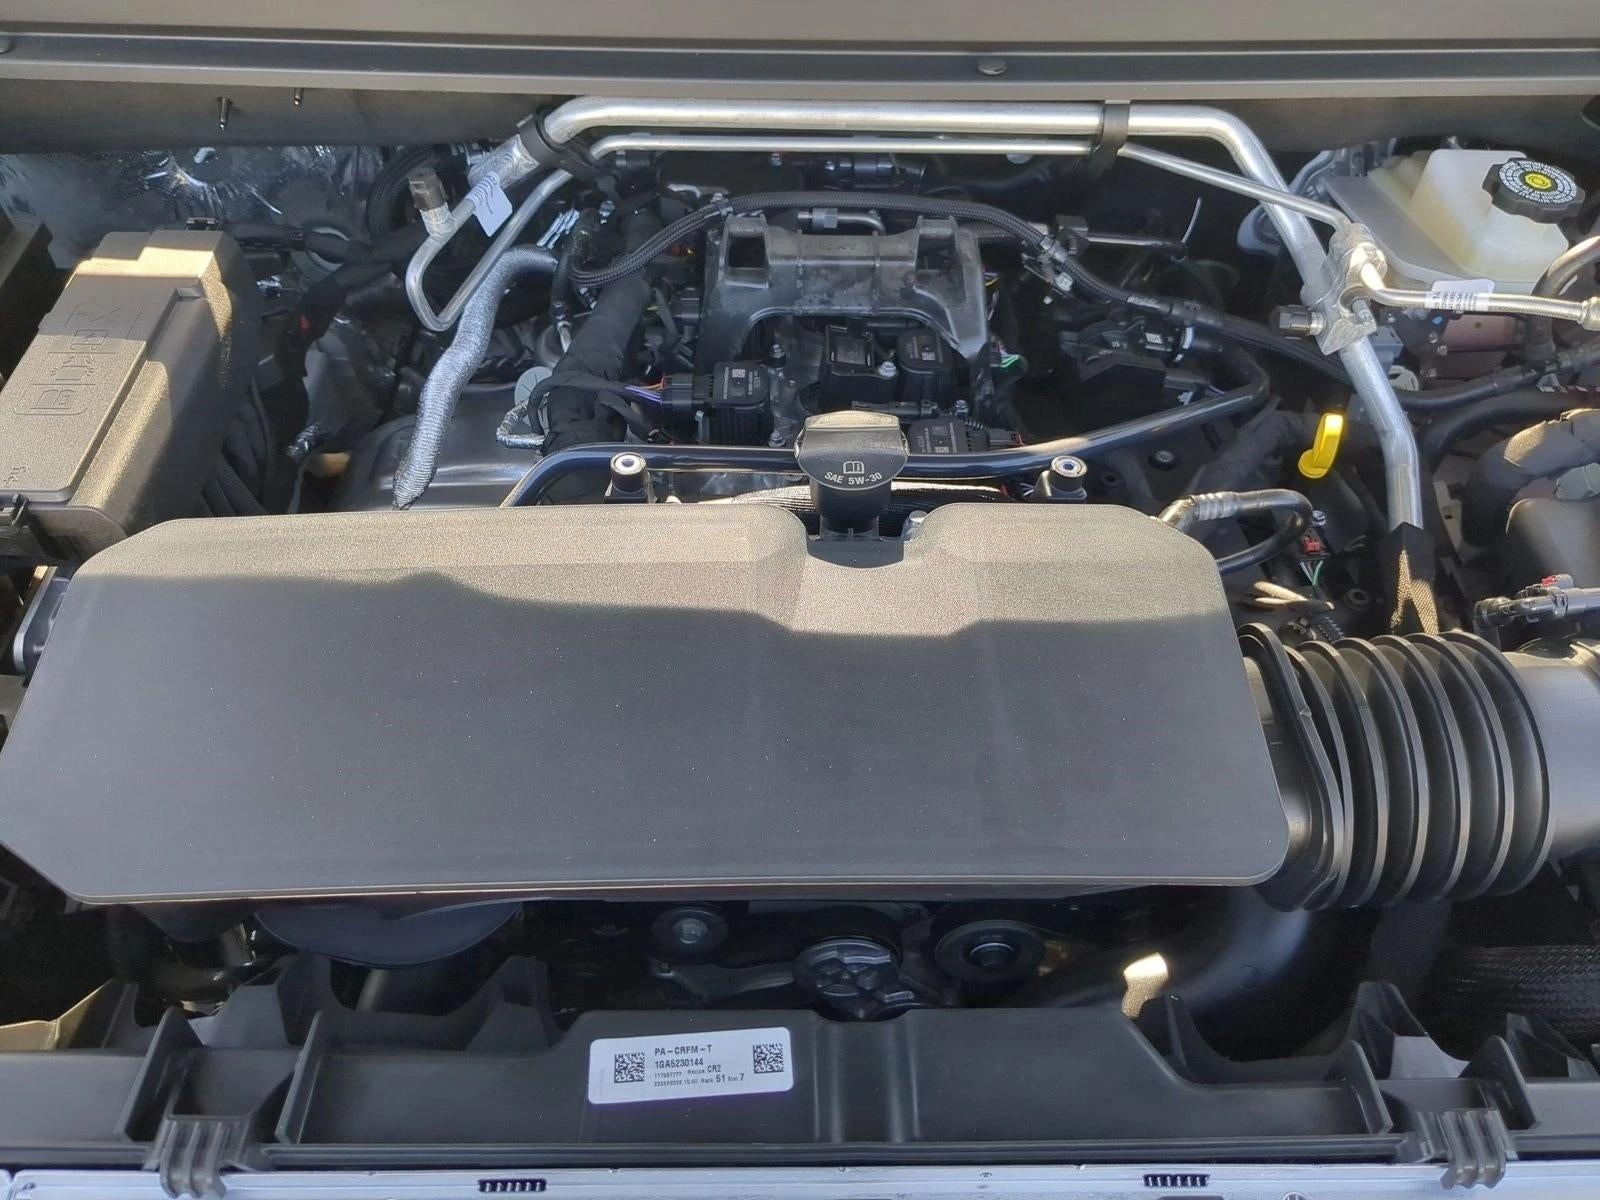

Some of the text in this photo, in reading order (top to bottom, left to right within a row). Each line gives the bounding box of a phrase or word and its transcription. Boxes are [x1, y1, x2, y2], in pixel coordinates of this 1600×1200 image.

[824, 472, 882, 485] SAE 5W-30
[655, 1058, 703, 1068] 1GA5230144
[707, 1064, 721, 1073] CR2
[716, 1075, 725, 1083] 51
[740, 1073, 745, 1081] 7
